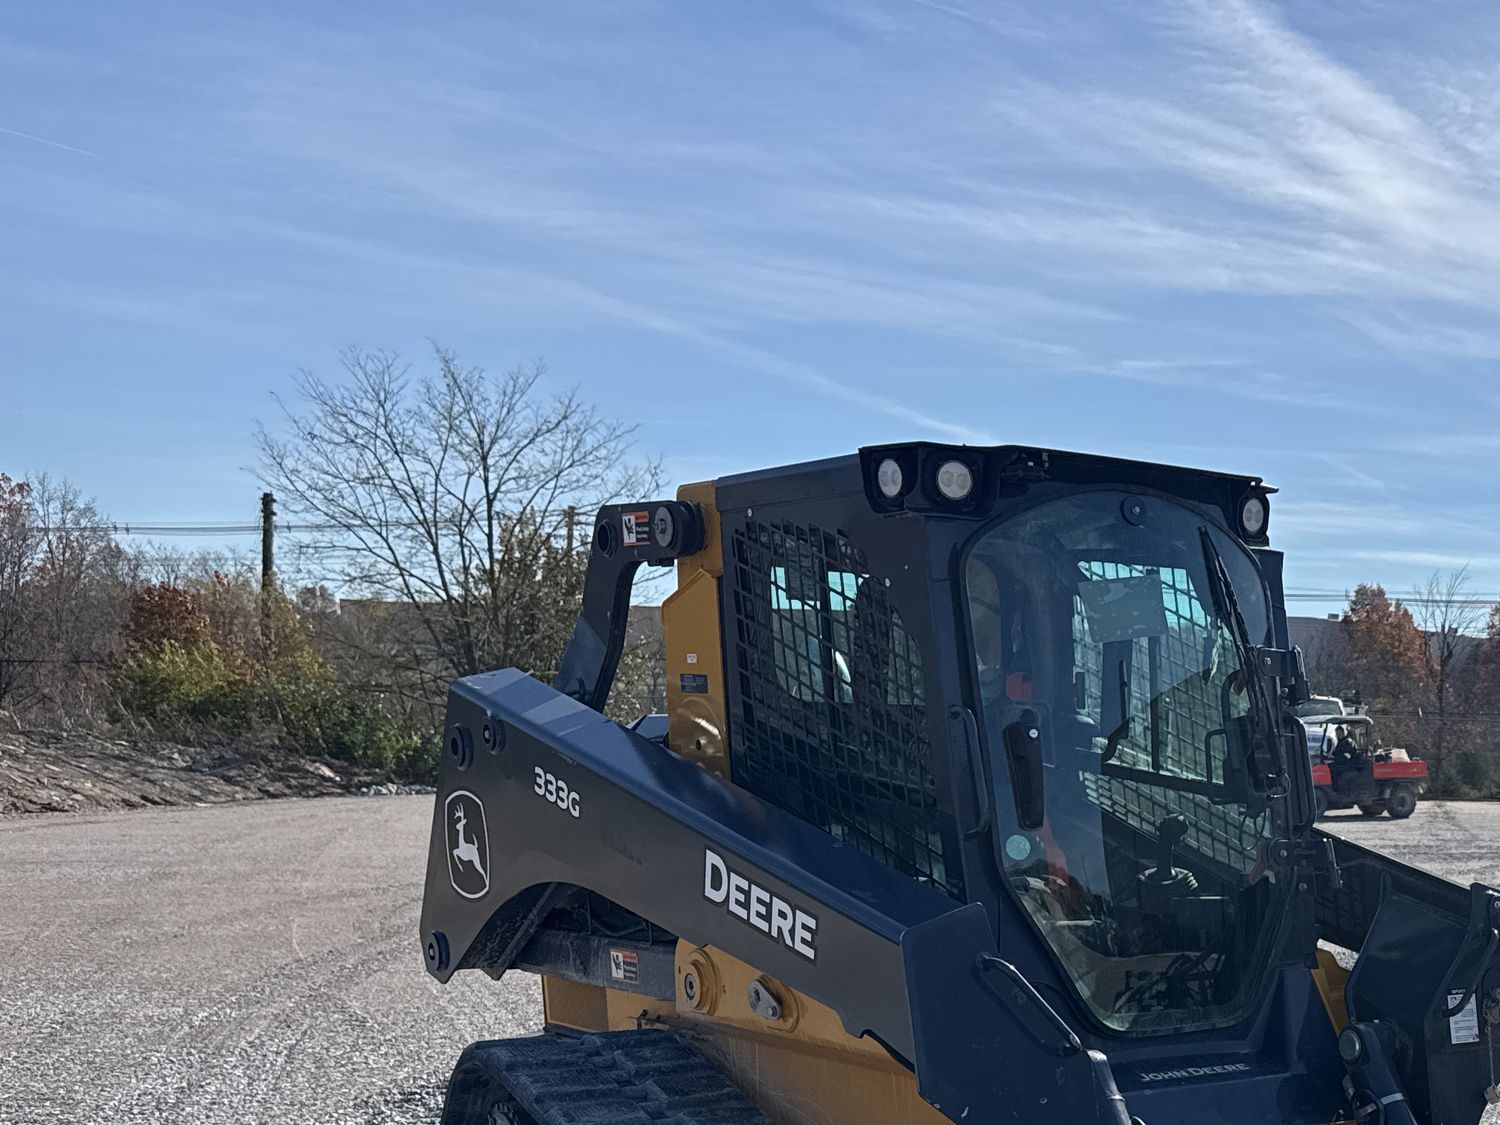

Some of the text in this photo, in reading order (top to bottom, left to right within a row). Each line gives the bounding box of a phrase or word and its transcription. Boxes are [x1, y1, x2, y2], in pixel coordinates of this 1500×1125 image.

[534, 766, 580, 818] 333G
[704, 848, 817, 960] DEERE
[1140, 1063, 1250, 1083] JOHN DEERE
